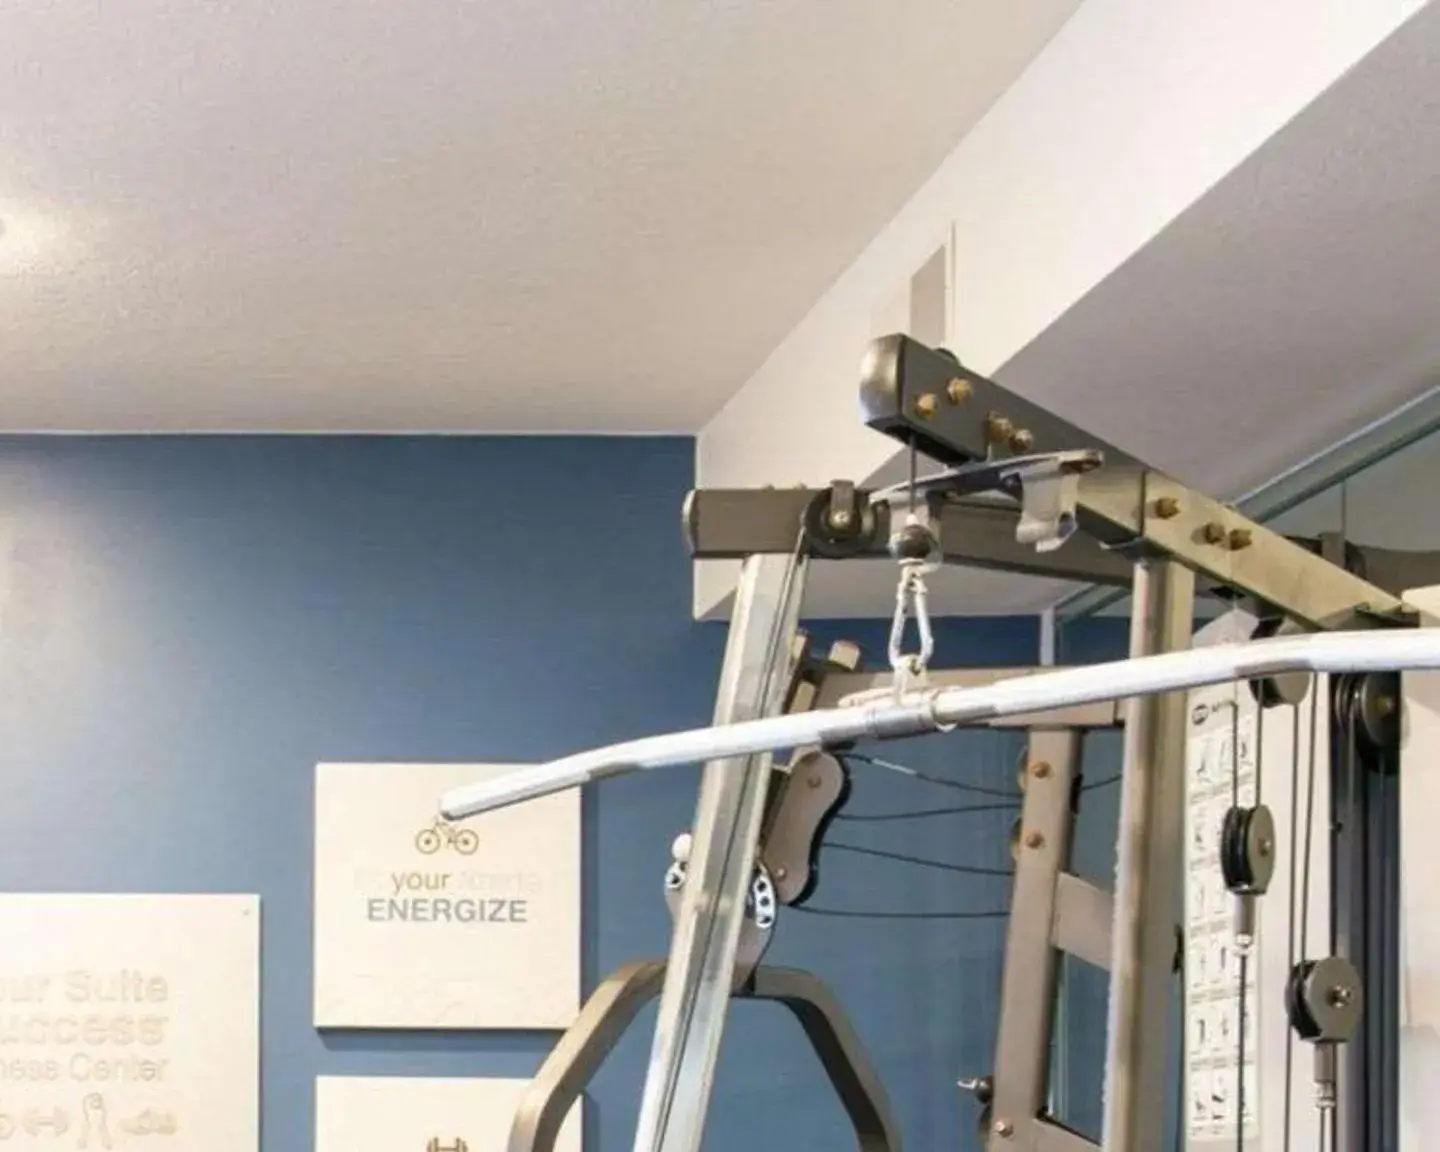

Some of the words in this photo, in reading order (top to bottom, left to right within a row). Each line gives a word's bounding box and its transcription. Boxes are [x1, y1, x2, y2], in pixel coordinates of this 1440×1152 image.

[390, 870, 452, 895] your
[366, 898, 529, 923] ENERGIZE
[64, 966, 169, 1004] Suite
[69, 1050, 170, 1082] Center
